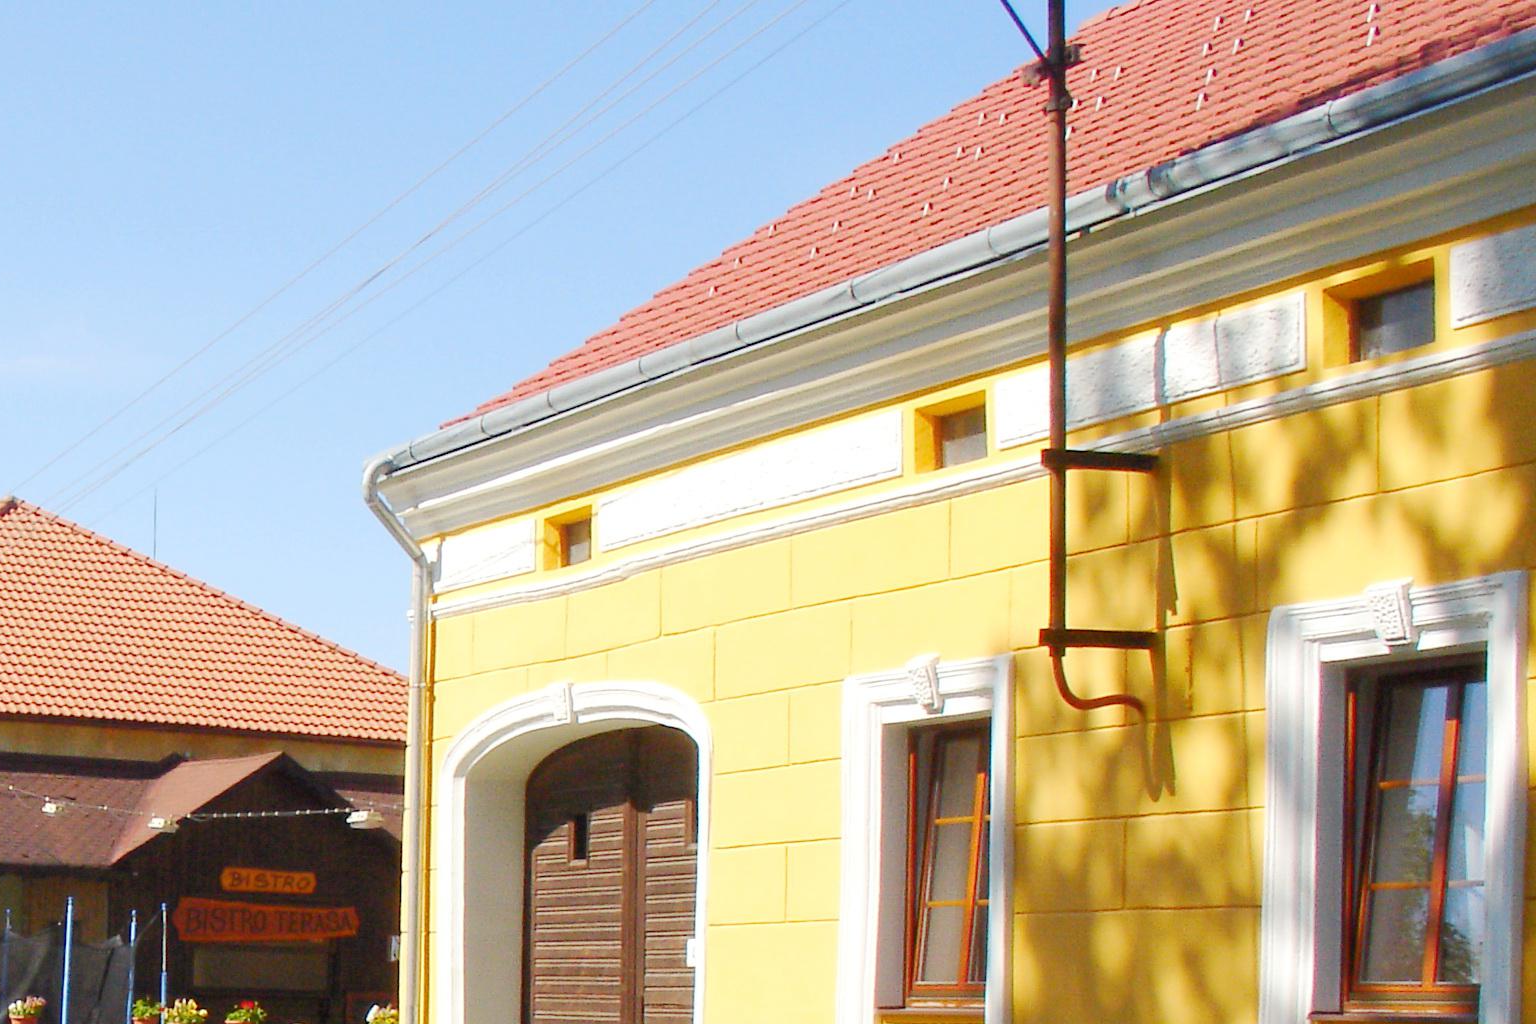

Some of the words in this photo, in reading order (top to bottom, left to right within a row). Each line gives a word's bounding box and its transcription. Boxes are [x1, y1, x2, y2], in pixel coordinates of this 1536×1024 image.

[229, 871, 311, 891] BISTRO
[185, 908, 267, 934] BISTRO
[276, 909, 354, 933] TERASA
